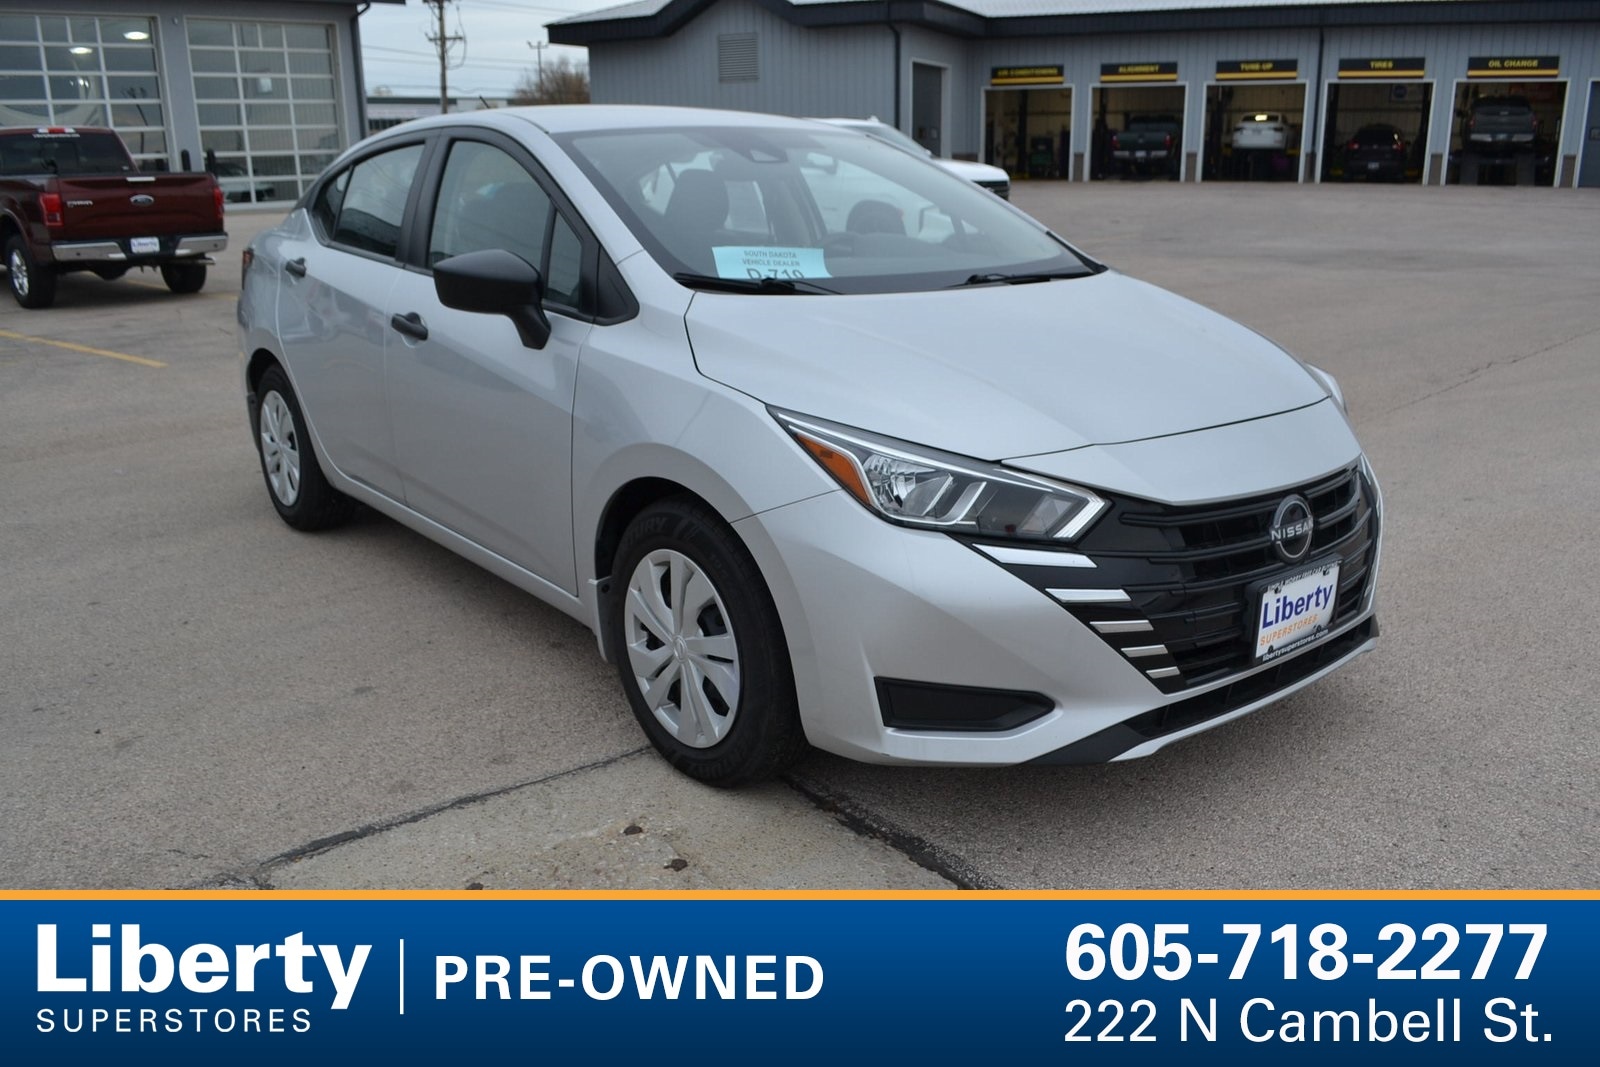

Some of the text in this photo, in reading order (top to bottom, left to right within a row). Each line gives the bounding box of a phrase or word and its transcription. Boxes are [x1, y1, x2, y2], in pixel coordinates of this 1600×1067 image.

[1370, 61, 1393, 69] TIRES
[1488, 60, 1501, 68] OIL
[769, 250, 797, 258] DAKOTA
[1262, 584, 1333, 629] Liberty
[1260, 614, 1319, 646] SUPERSTORES
